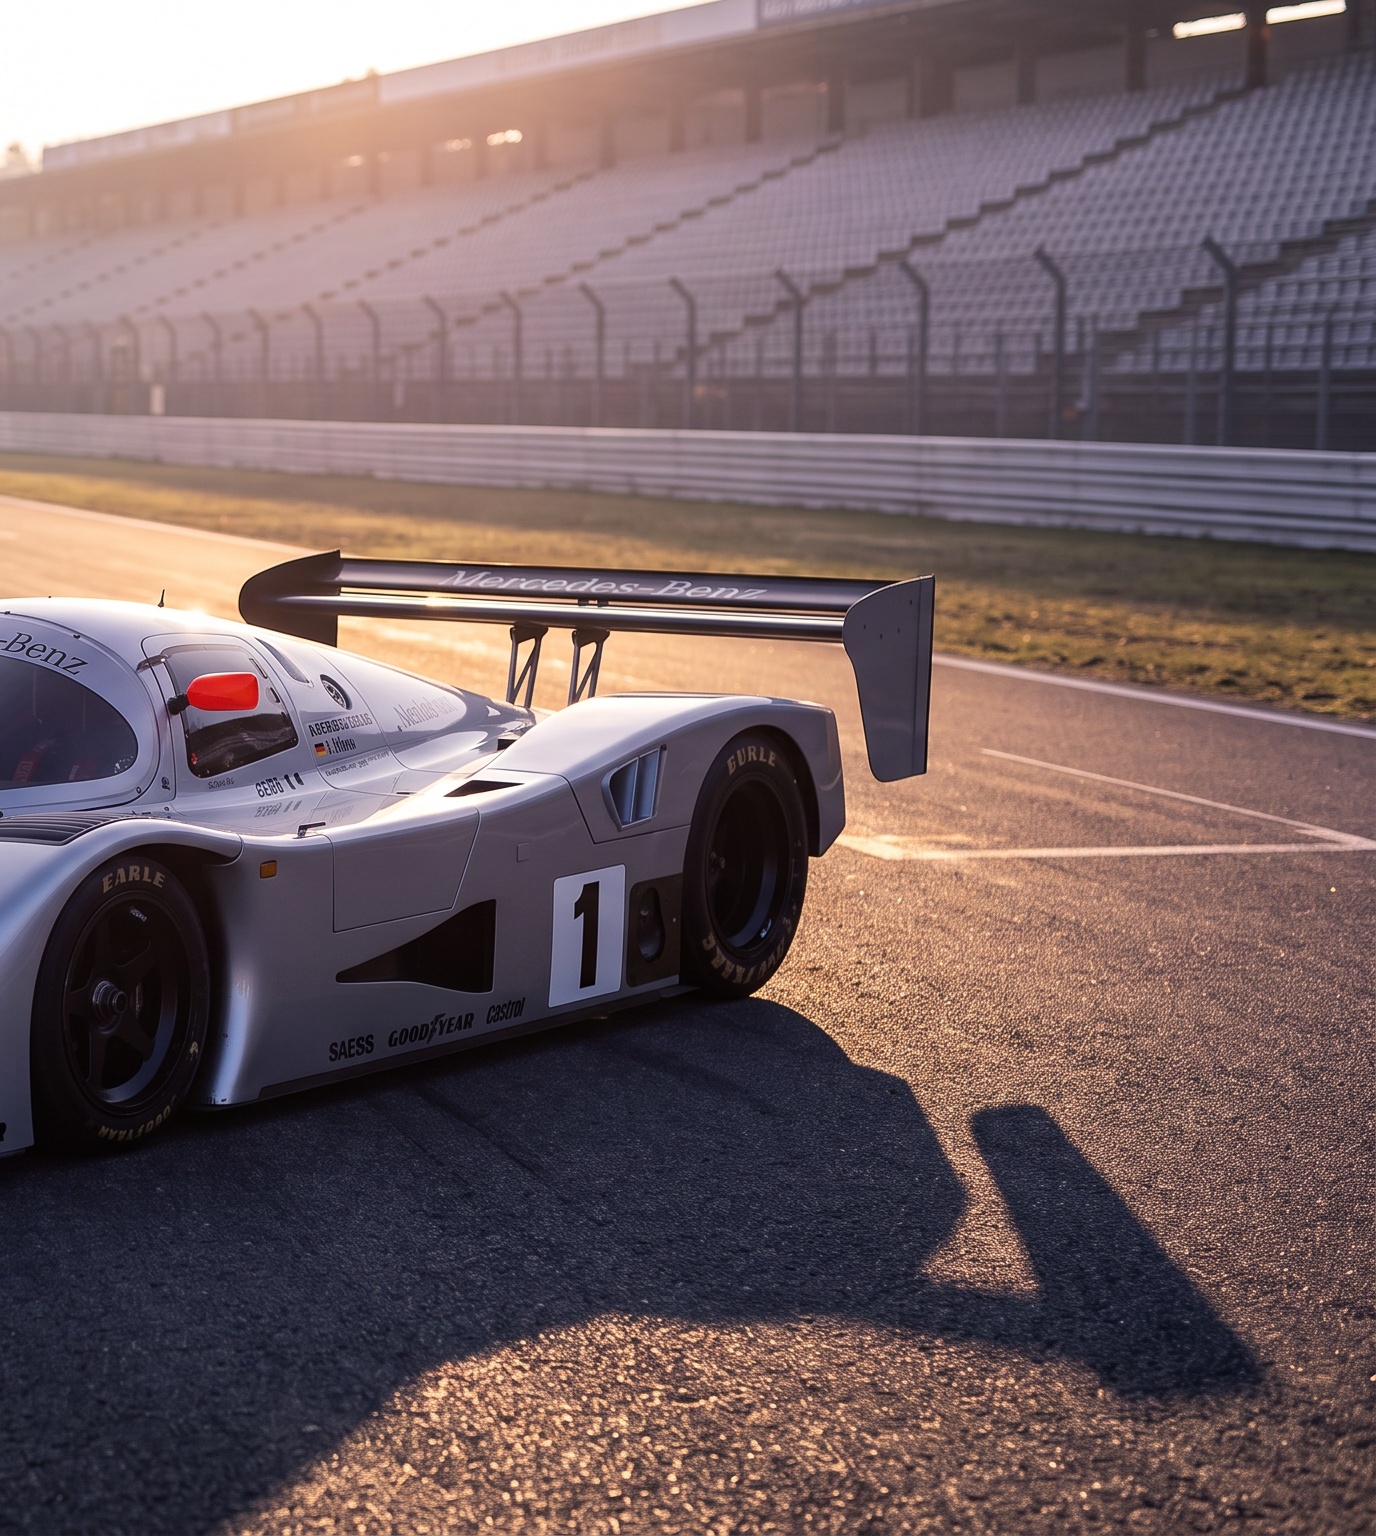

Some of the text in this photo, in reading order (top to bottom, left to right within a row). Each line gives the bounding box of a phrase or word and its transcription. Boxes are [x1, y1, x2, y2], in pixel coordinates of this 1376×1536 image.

[438, 570, 768, 600] Mercedes-Benz
[102, 864, 166, 894] EARLE
[574, 880, 600, 990] 1
[328, 1034, 374, 1062] SAESS
[486, 997, 526, 1025] Castrol
